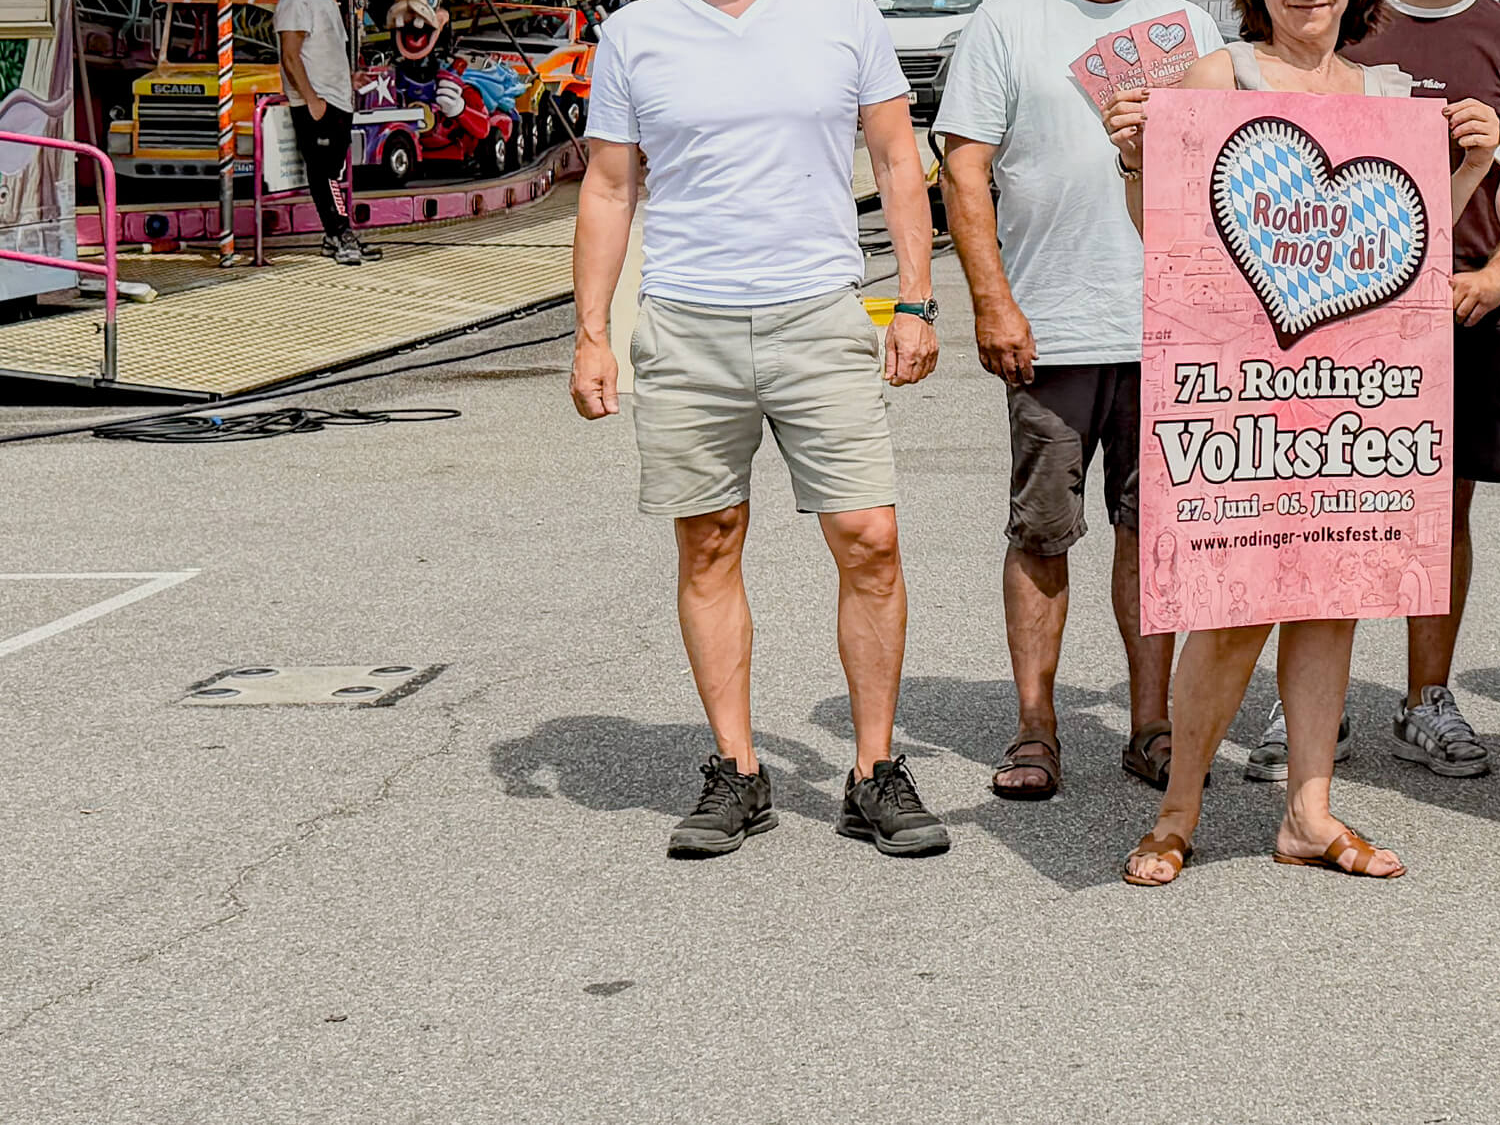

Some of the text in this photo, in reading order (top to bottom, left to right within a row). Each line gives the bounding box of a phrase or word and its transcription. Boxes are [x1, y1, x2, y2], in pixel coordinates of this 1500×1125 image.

[153, 84, 202, 94] SCANIA
[1252, 191, 1348, 238] Roding
[1272, 227, 1387, 274] mog di!
[1174, 356, 1422, 408] 71. Rodinger
[1152, 411, 1443, 487] Volksfest
[1177, 490, 1415, 524] 27. Juni - 05. Juli 2026
[1190, 526, 1402, 551] www.rodinger-volksfest.de
